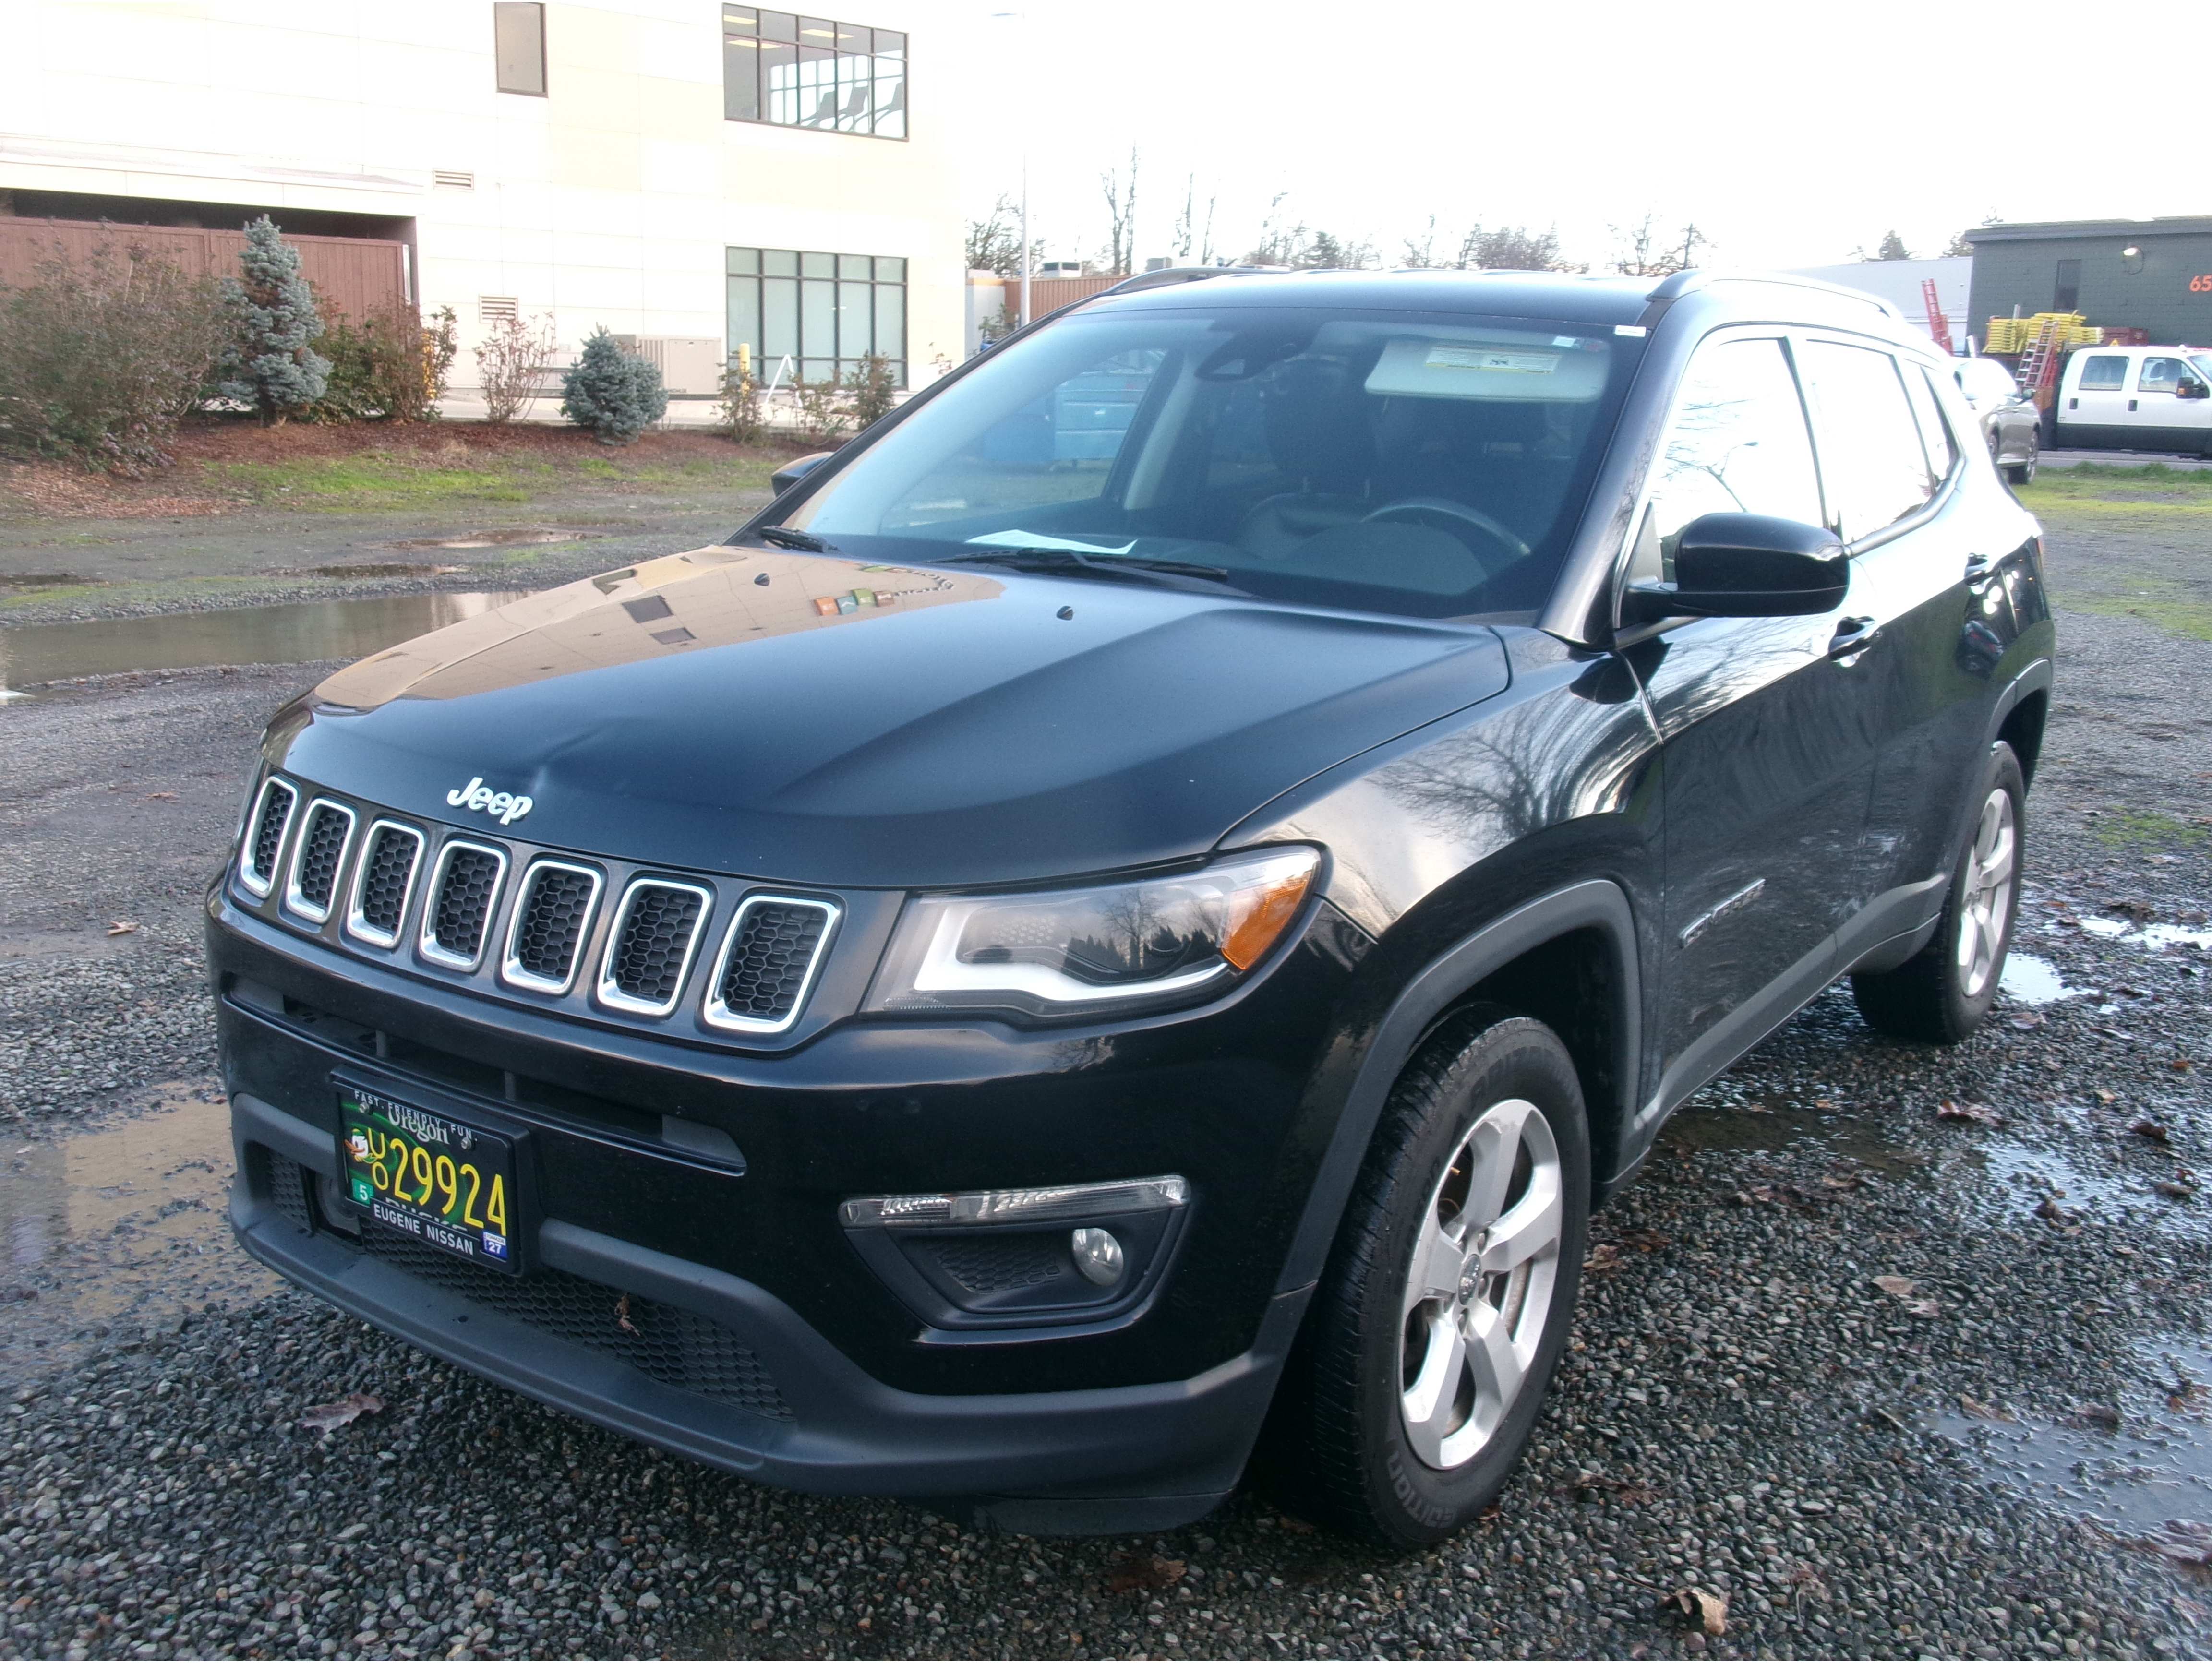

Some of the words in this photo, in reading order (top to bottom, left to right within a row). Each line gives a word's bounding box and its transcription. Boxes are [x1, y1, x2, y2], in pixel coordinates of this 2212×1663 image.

[447, 777, 533, 826] Jeep
[359, 1184, 368, 1200] 5
[373, 1203, 421, 1235] EUGENE
[426, 1225, 474, 1256] NISSAN
[488, 1241, 502, 1255] 27
